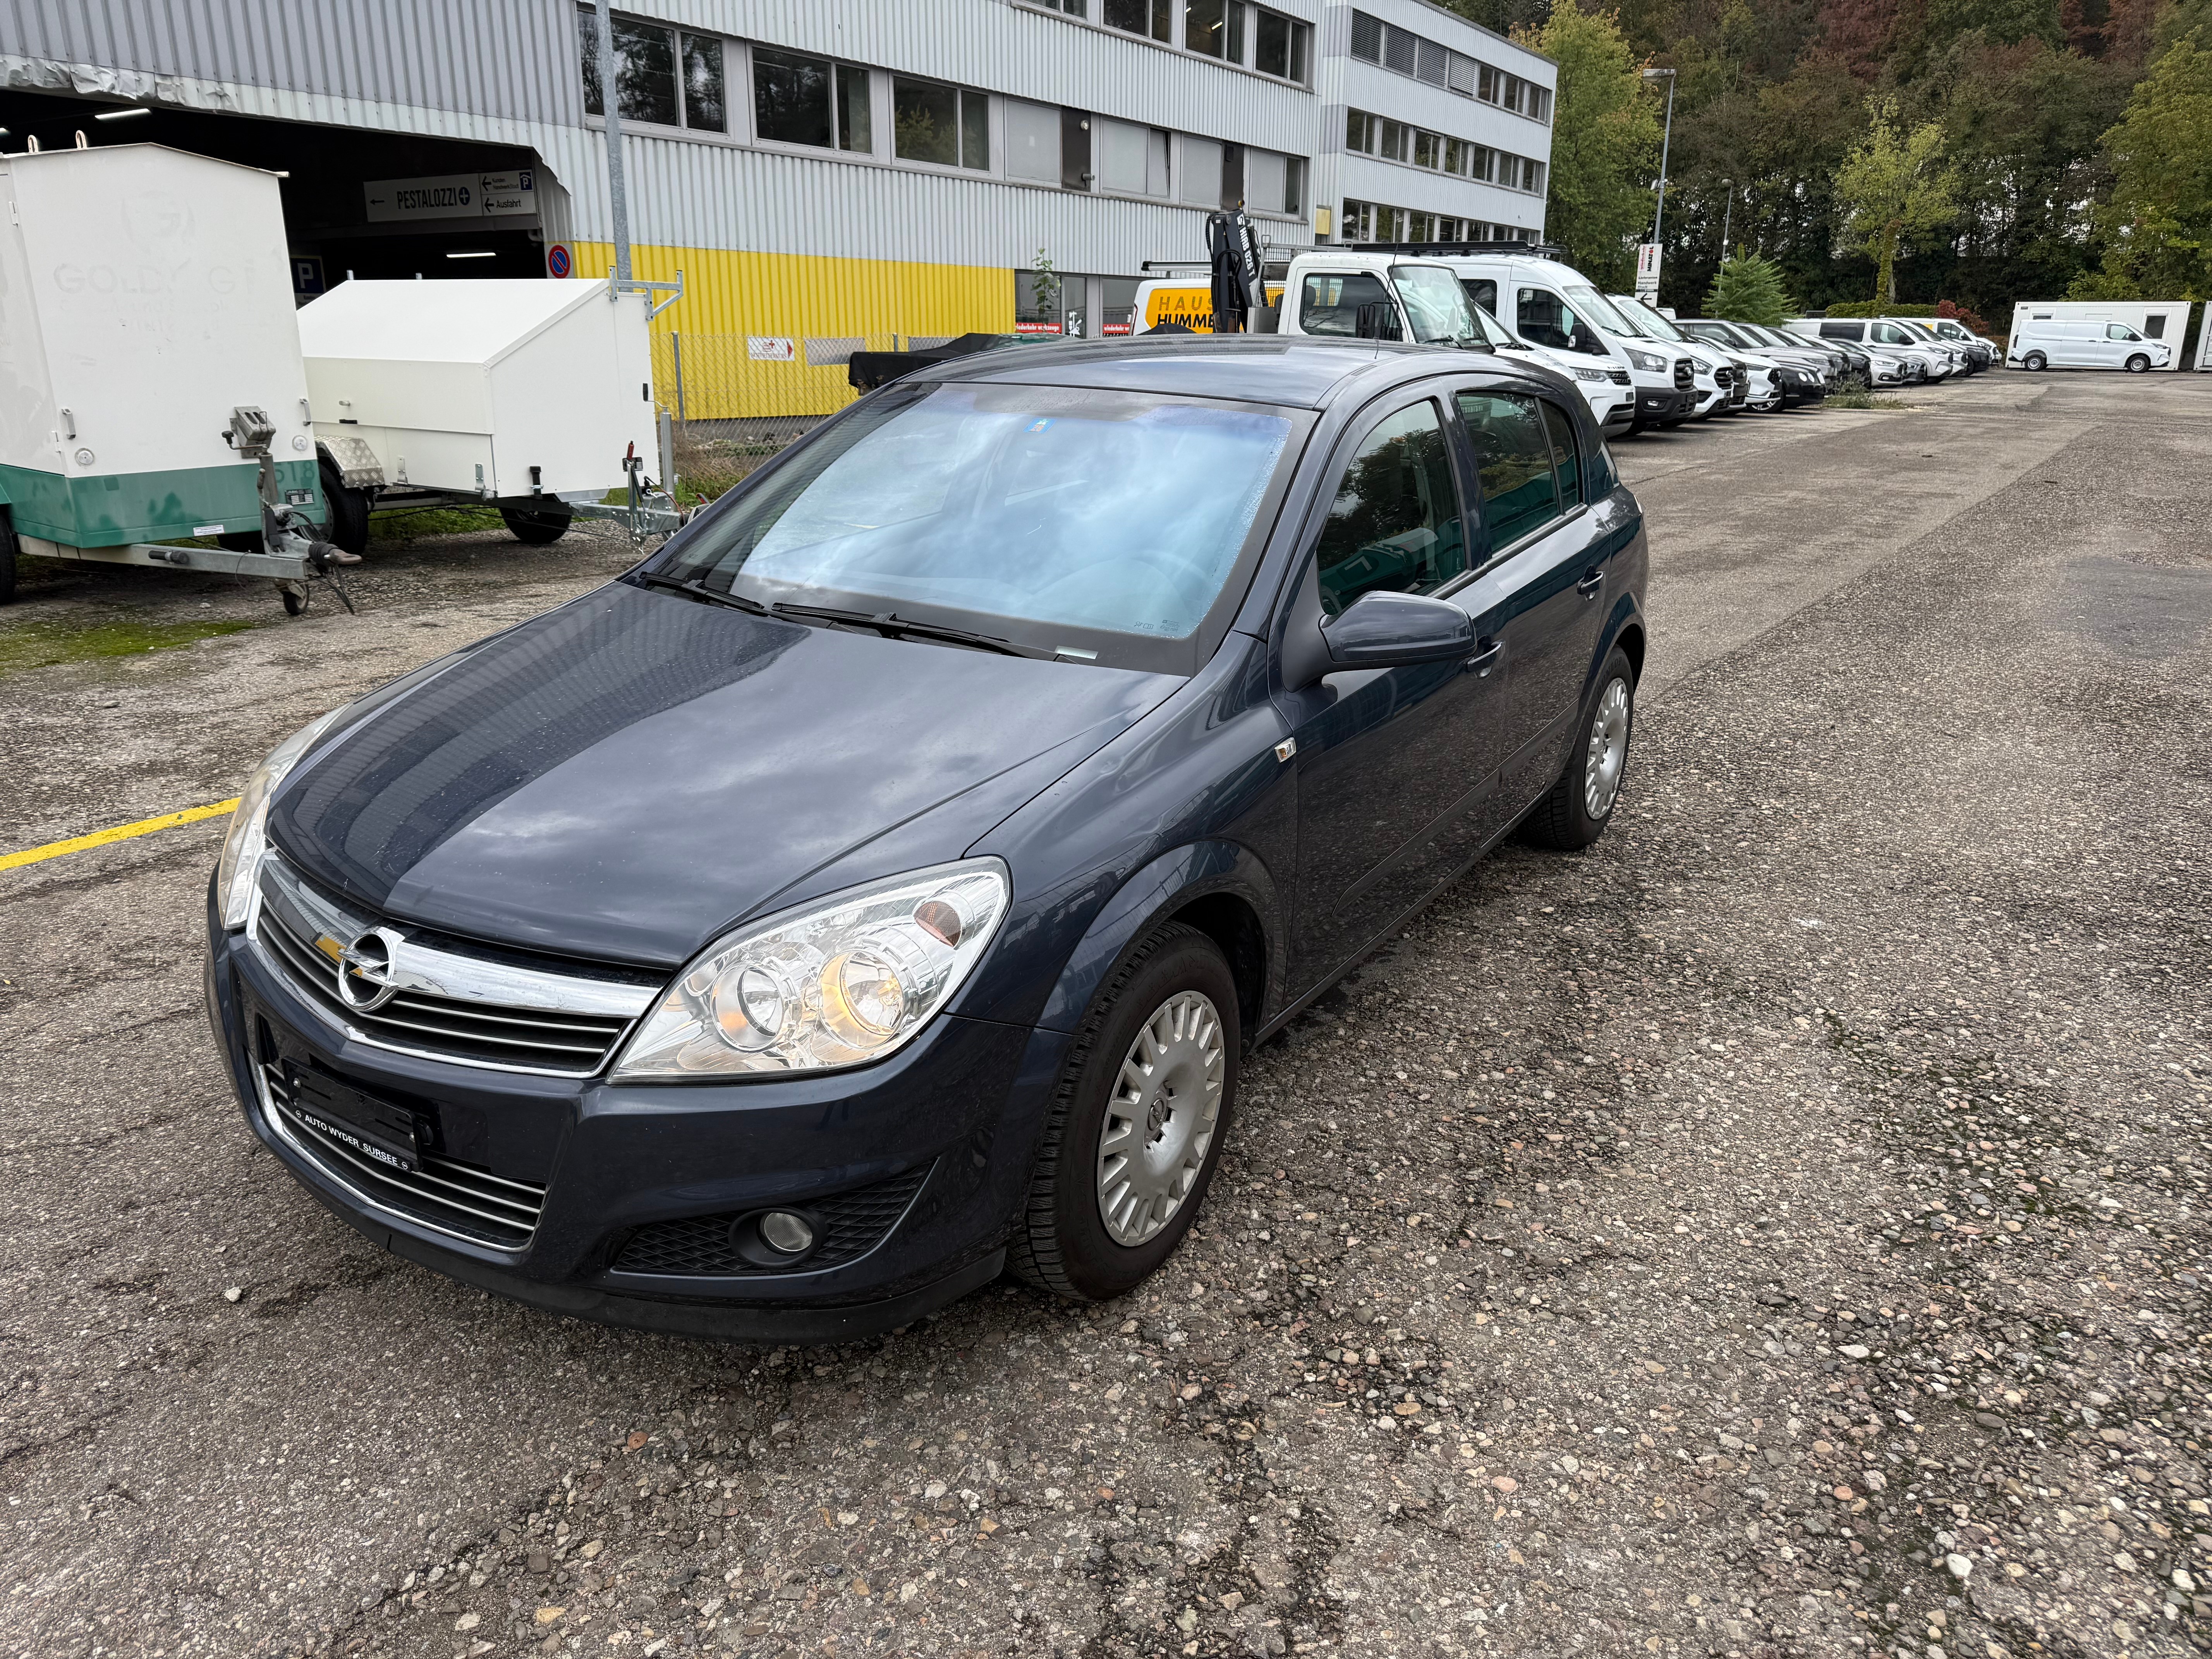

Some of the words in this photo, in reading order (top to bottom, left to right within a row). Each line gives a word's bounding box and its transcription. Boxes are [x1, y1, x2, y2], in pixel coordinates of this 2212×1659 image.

[397, 187, 457, 209] PESTALOZZI
[496, 199, 521, 208] Ausfahrt
[1244, 250, 1254, 270] 026
[297, 263, 313, 289] P
[1159, 296, 1213, 311] HAUS
[305, 1115, 327, 1131] AUTO
[329, 1126, 359, 1147] WYDER
[363, 1143, 398, 1165] SURSEE
